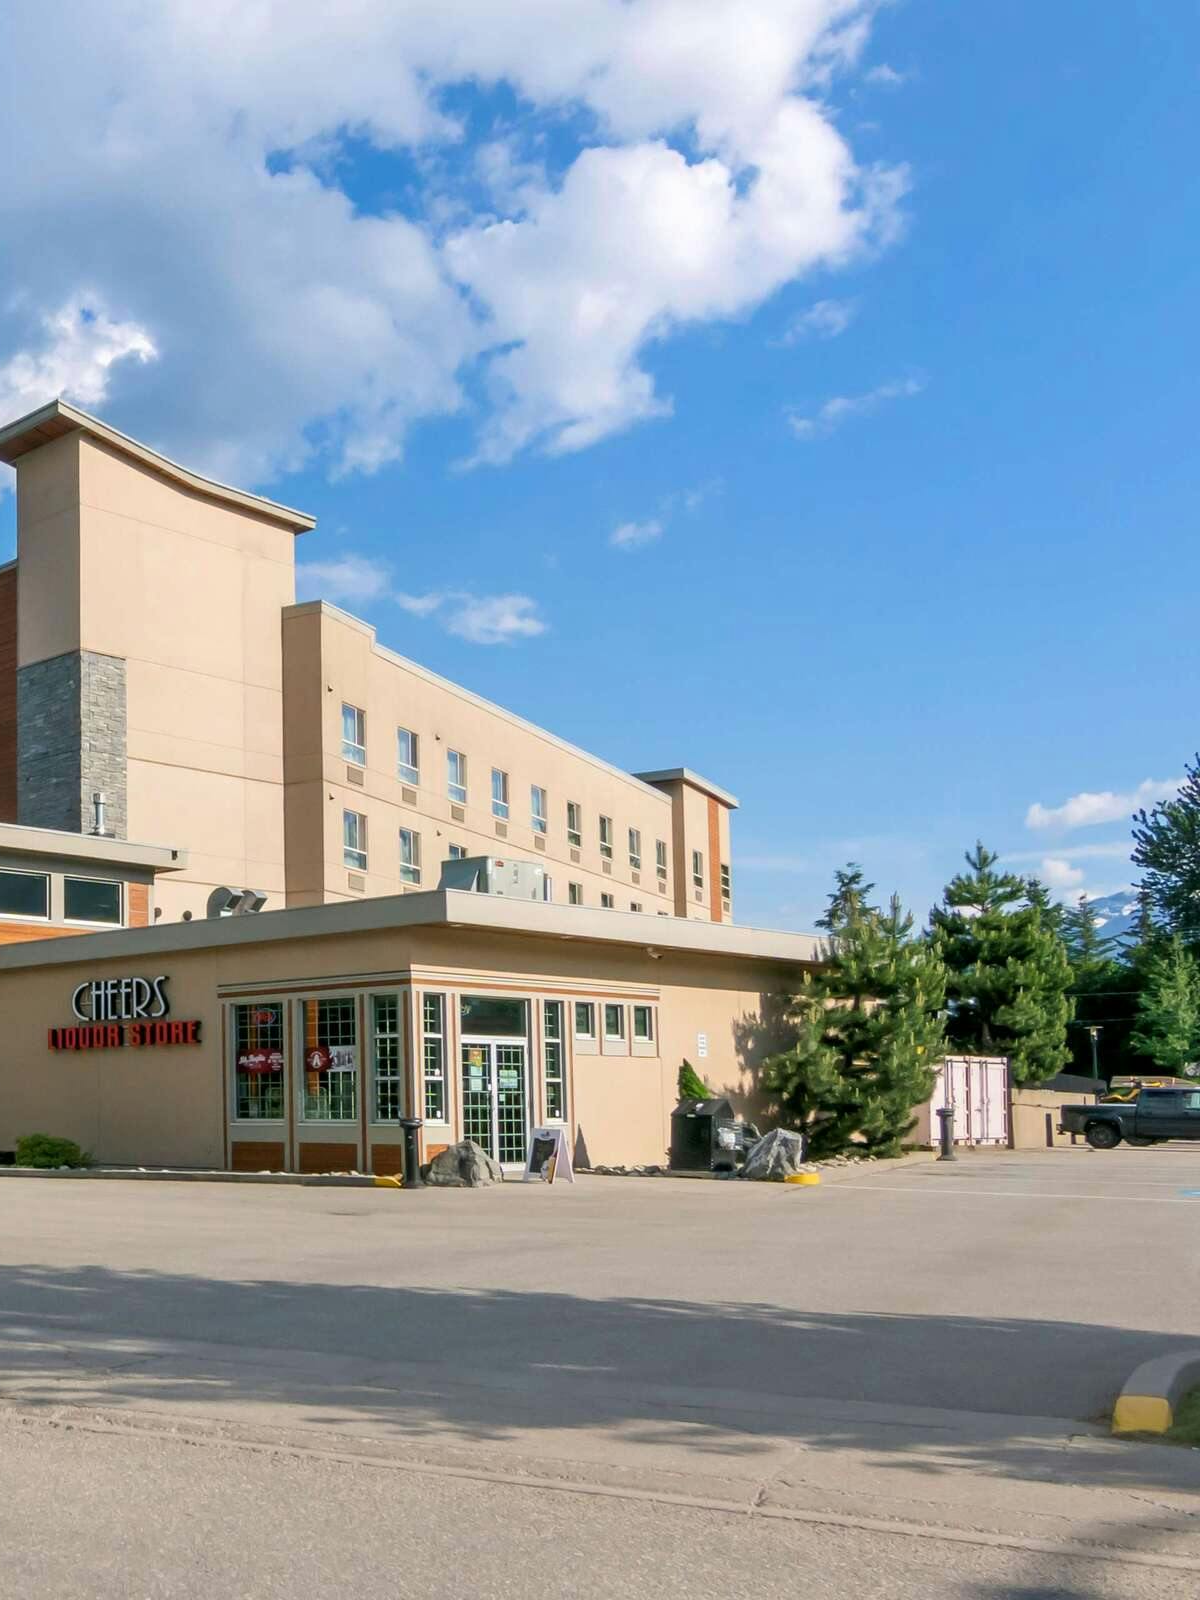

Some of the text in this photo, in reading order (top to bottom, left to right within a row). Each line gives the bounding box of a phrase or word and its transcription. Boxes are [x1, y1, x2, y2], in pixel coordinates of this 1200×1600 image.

[71, 975, 169, 1022] CHEERS
[48, 1020, 201, 1051] LIQUOR STORE
